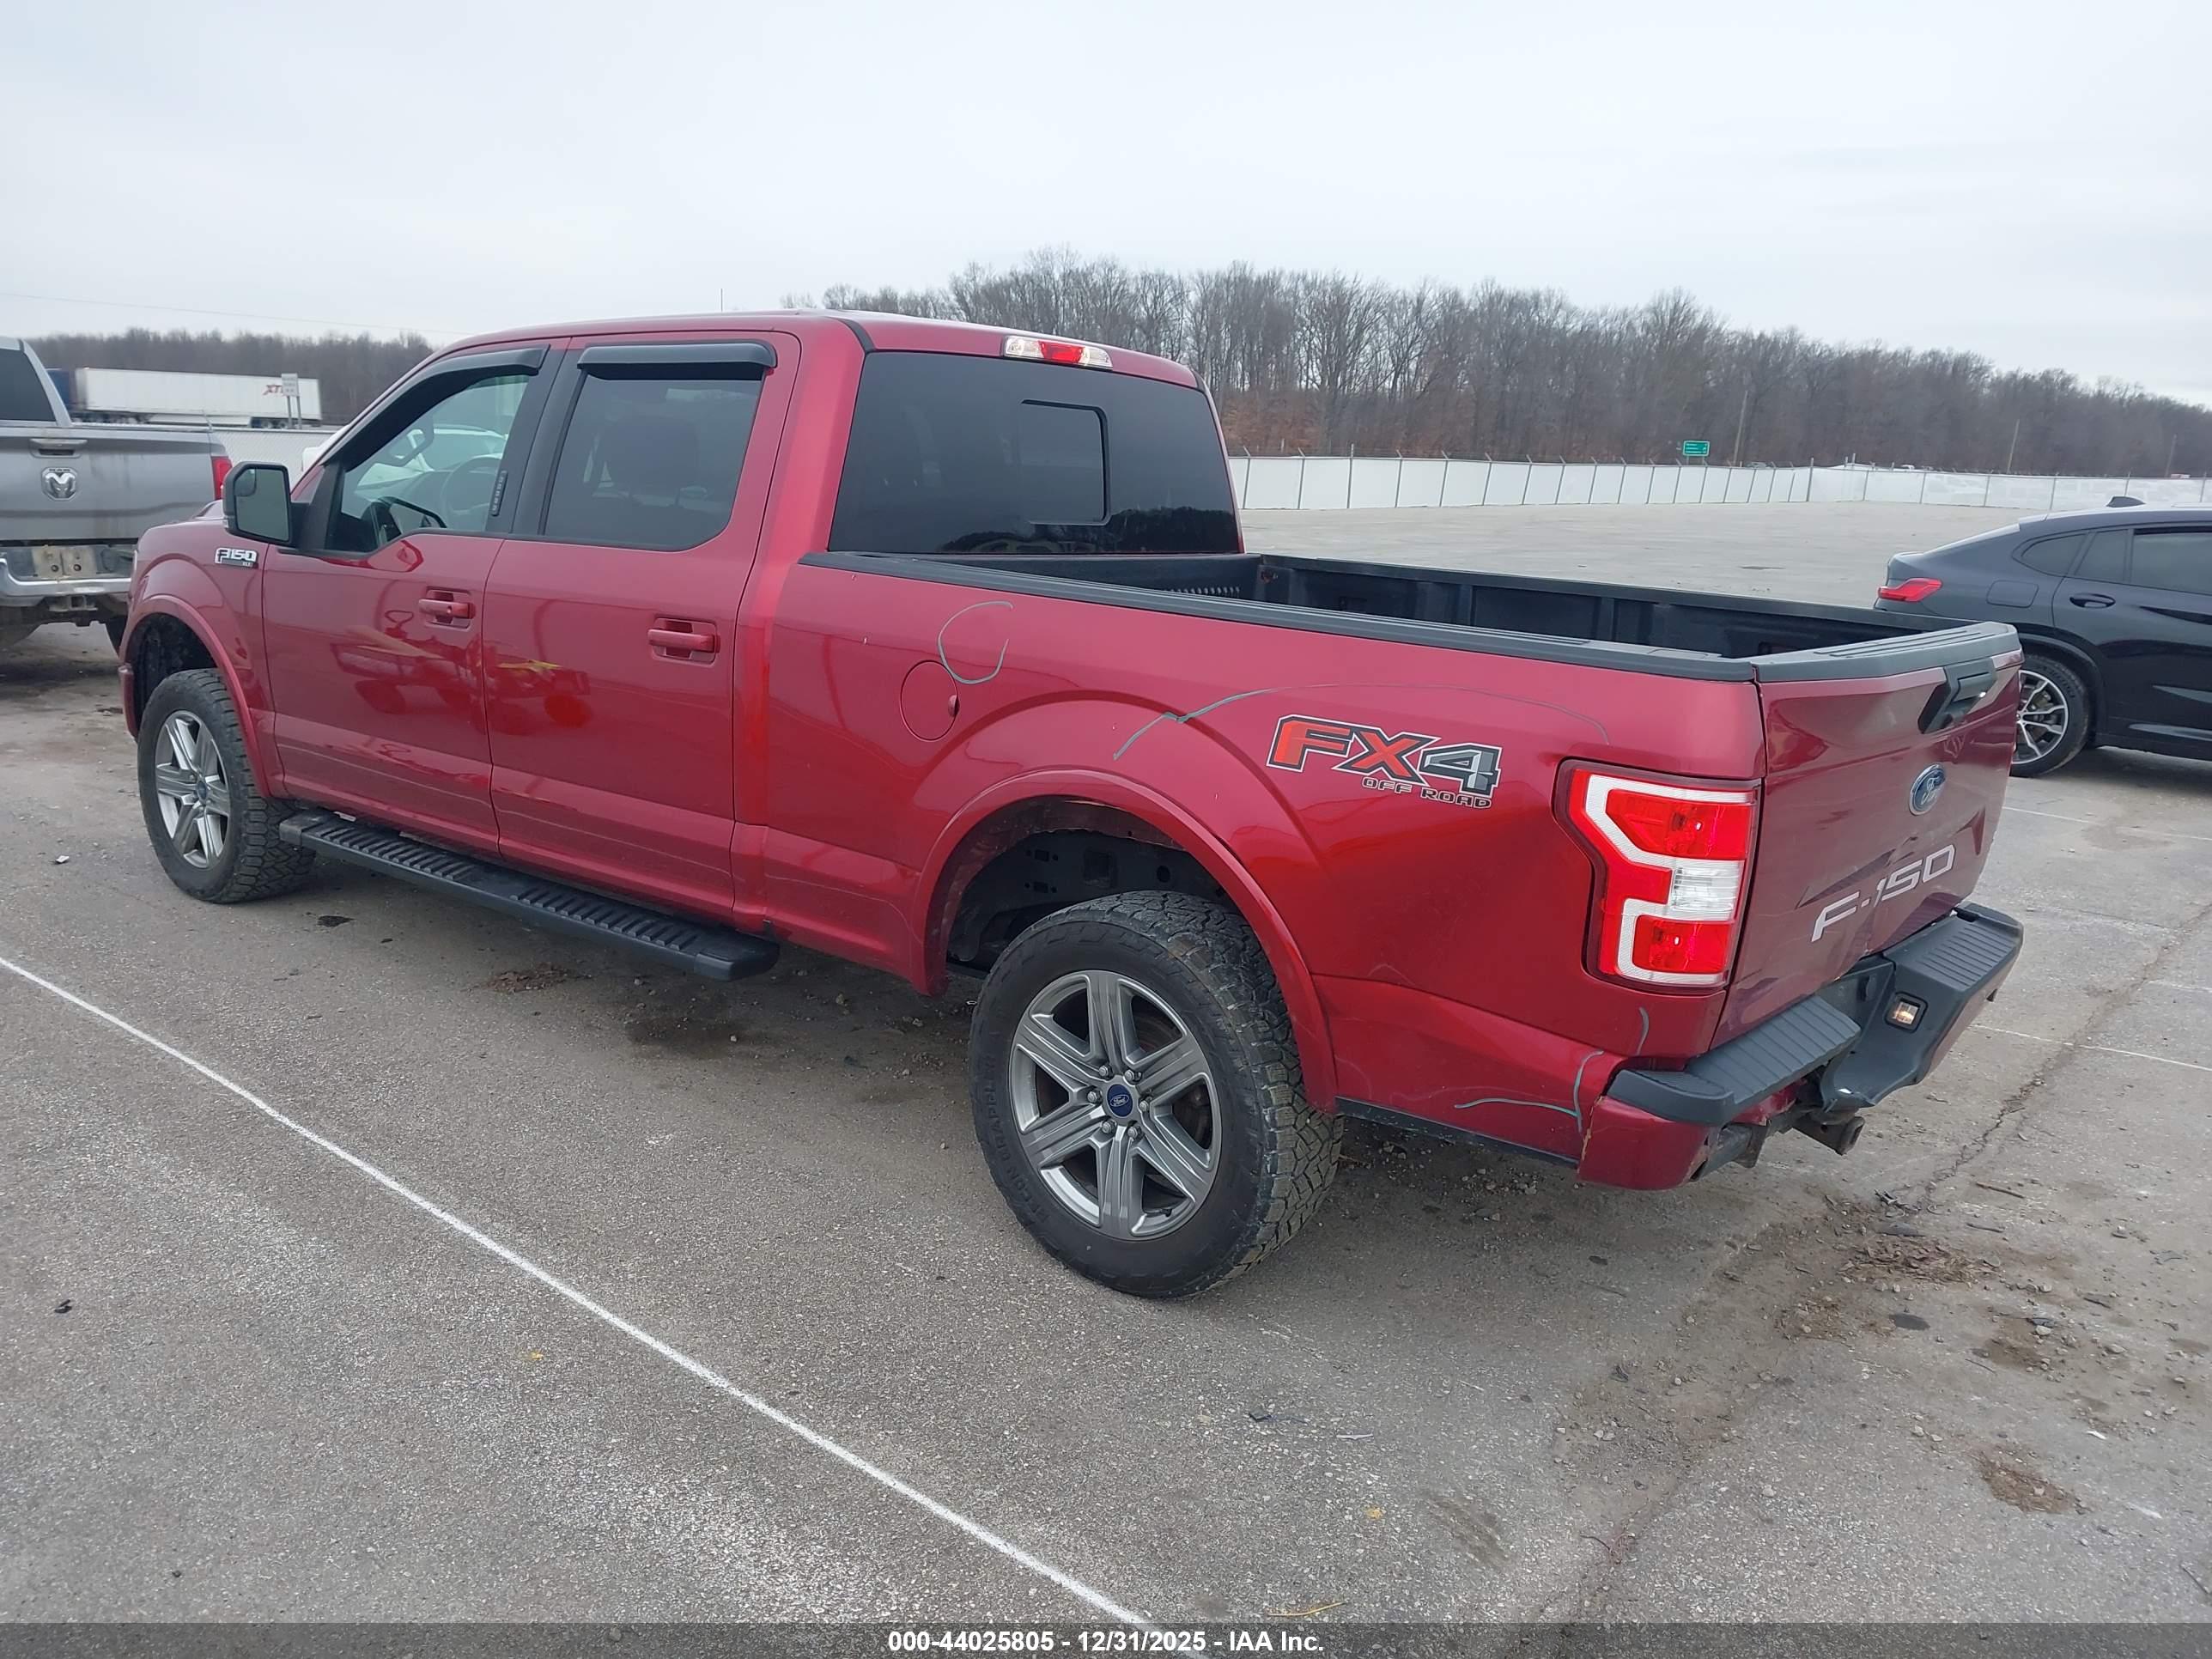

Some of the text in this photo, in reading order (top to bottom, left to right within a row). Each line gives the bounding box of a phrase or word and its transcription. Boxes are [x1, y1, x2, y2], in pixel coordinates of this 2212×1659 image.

[1266, 714, 1503, 799] FX4
[1362, 776, 1492, 810] OFF ROAD
[1811, 844, 1956, 943] F-150
